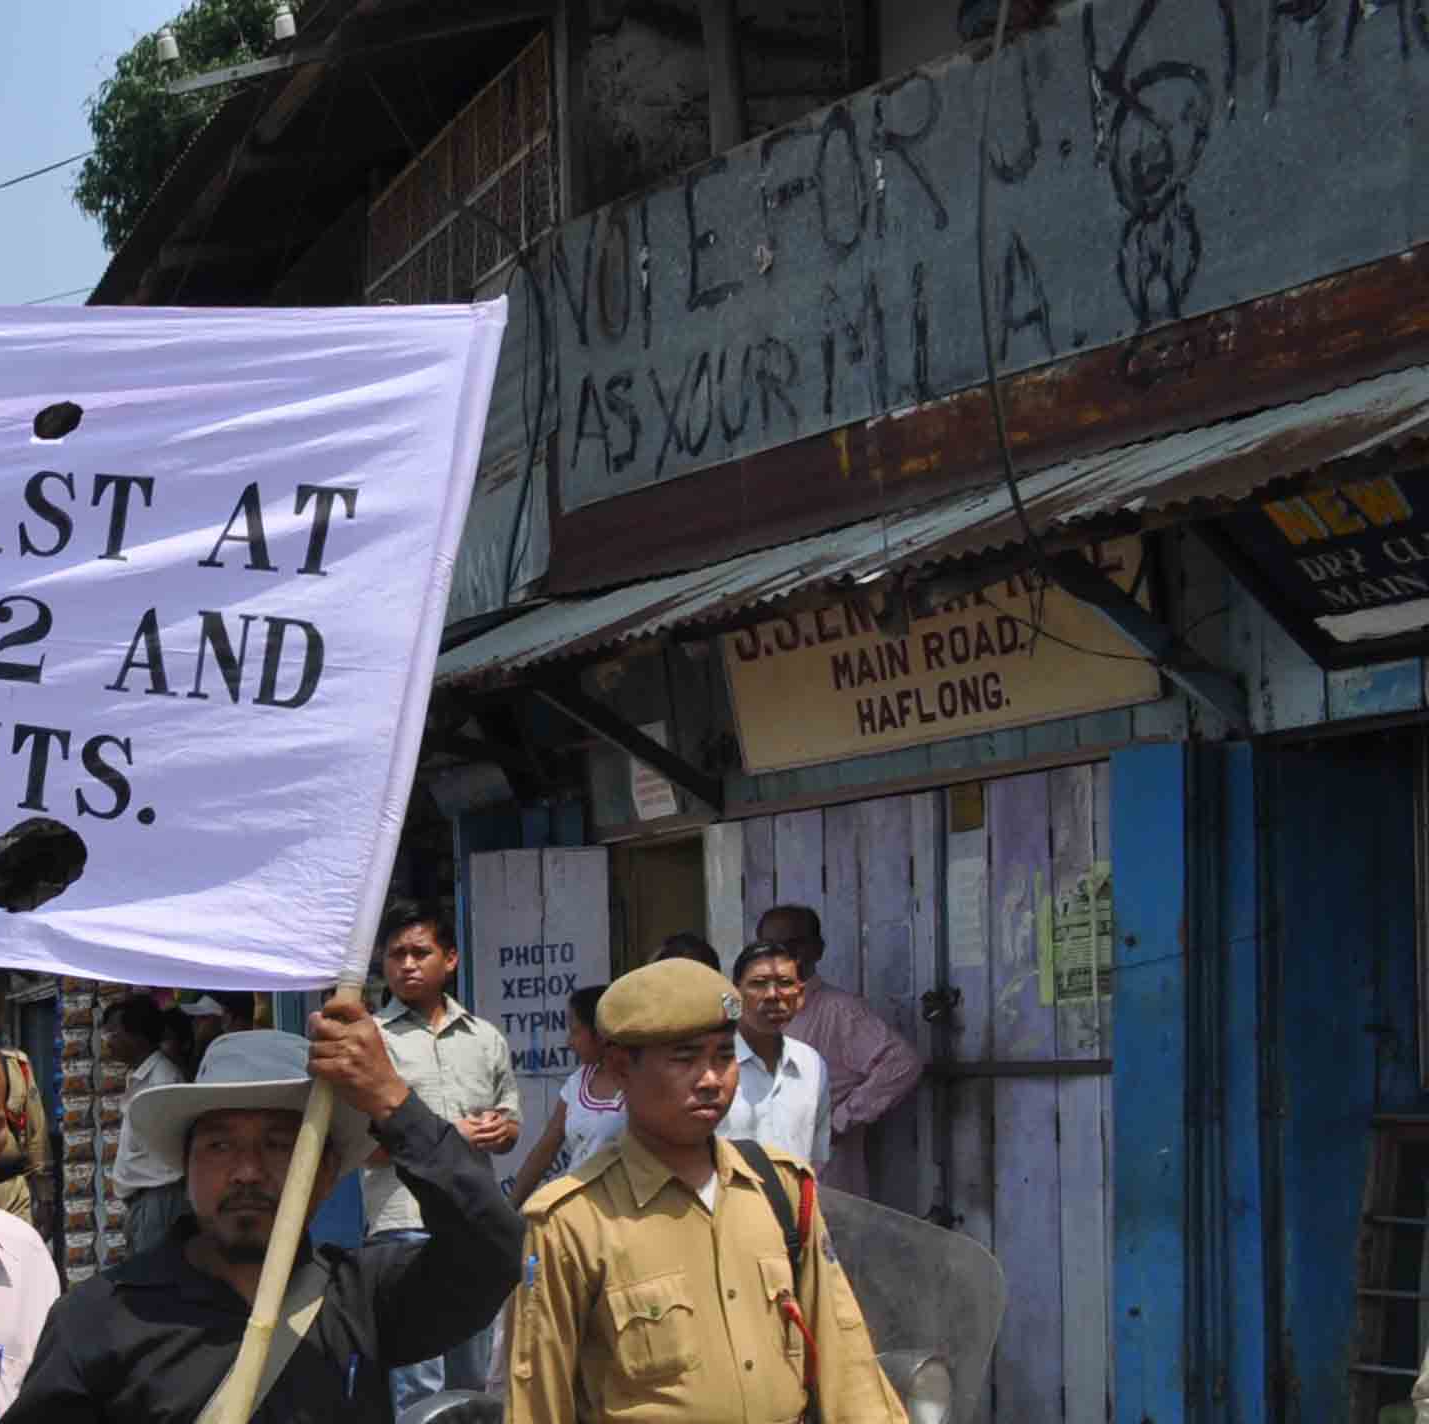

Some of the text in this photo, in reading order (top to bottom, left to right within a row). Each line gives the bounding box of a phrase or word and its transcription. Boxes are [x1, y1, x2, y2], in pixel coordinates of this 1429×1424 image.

[197, 482, 358, 577] AT
[1263, 476, 1413, 544] NEW
[1298, 548, 1365, 582] DRY
[106, 606, 324, 711] AND
[830, 640, 909, 692] MAIN
[923, 614, 1026, 669] ROAD.
[856, 671, 1011, 737] HAFLONG.
[499, 942, 574, 968] PHOTO
[501, 973, 578, 1000] XEROX
[501, 1010, 566, 1034] TYPIN
